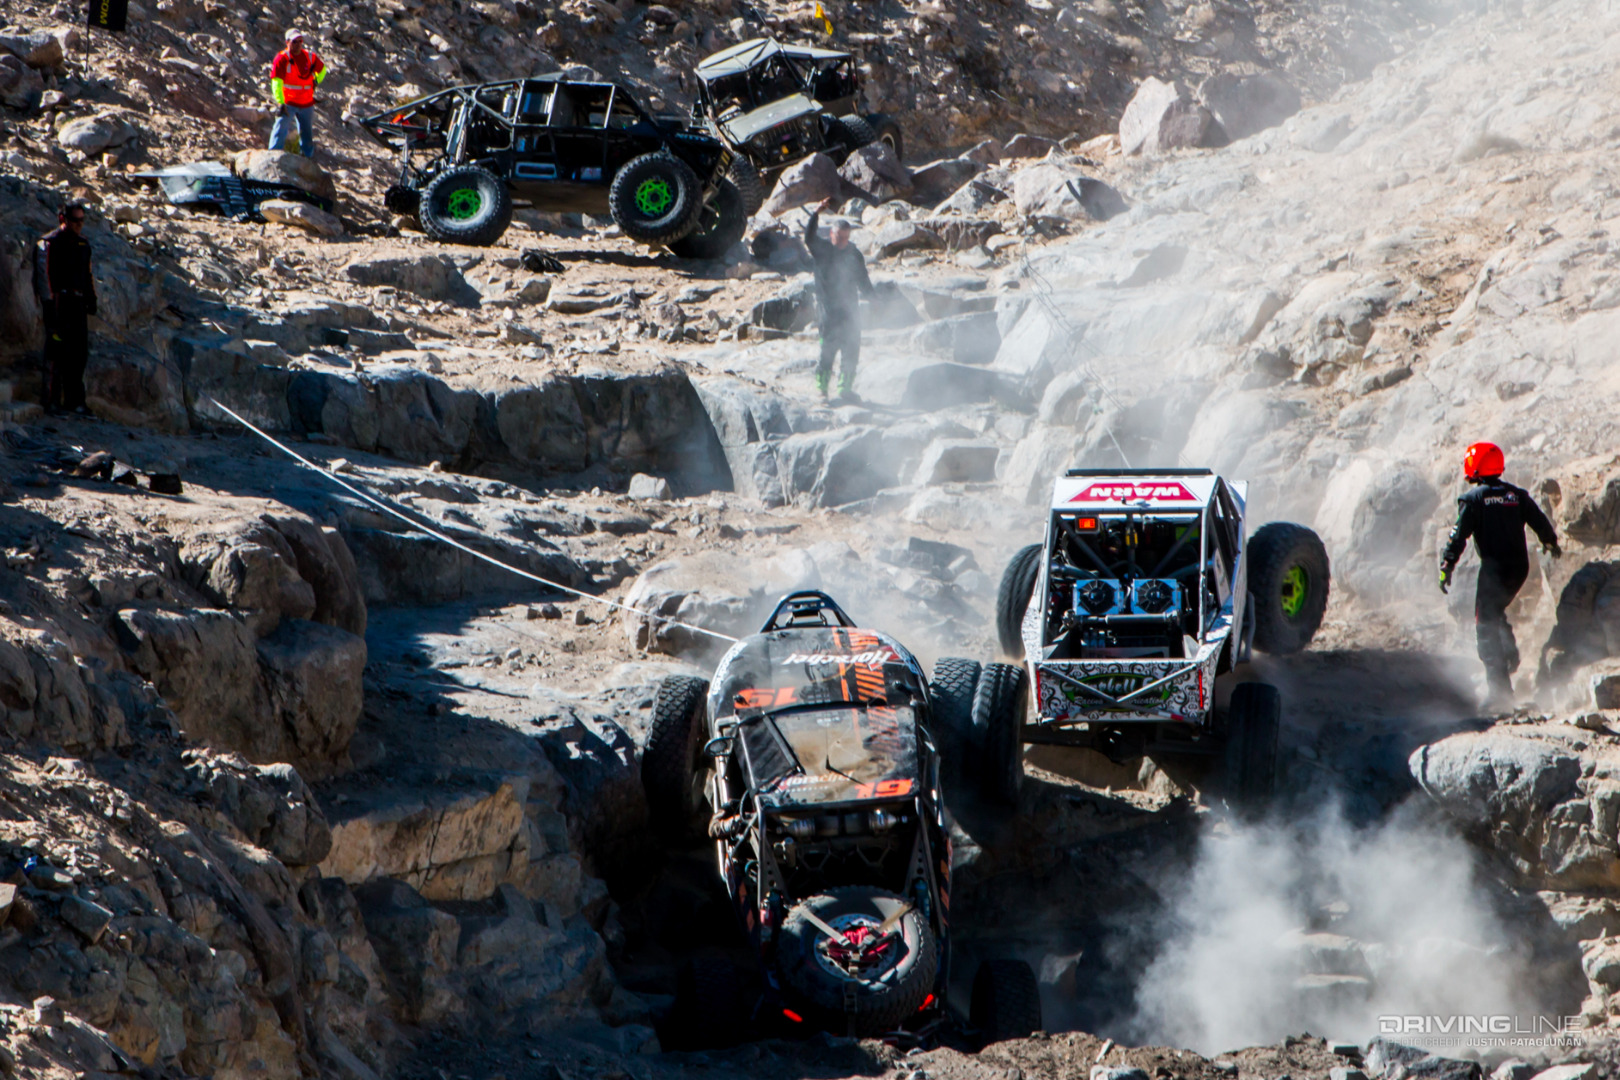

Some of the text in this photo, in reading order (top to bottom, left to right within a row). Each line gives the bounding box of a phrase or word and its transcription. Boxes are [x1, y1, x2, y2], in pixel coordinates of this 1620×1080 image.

[1090, 486, 1180, 498] WARN
[782, 650, 893, 667] Horschel
[734, 686, 798, 709] 19
[855, 779, 914, 799] 19
